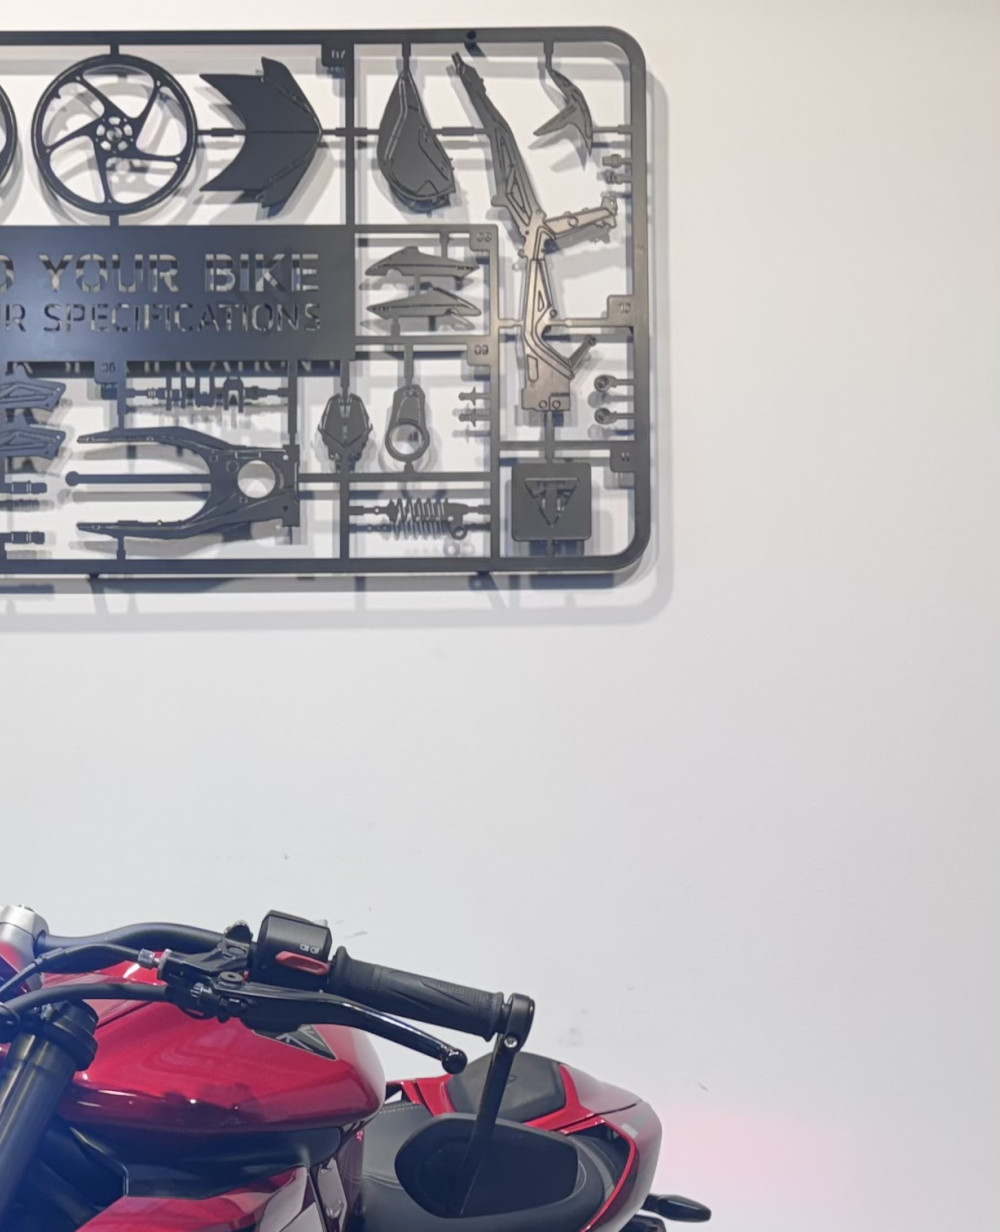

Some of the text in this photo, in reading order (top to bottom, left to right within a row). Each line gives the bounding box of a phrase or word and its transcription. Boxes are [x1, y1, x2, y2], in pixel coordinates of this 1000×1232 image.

[39, 253, 179, 293] YOUR
[204, 253, 320, 293] BIKE
[42, 303, 322, 332] SPECIFICATIONS
